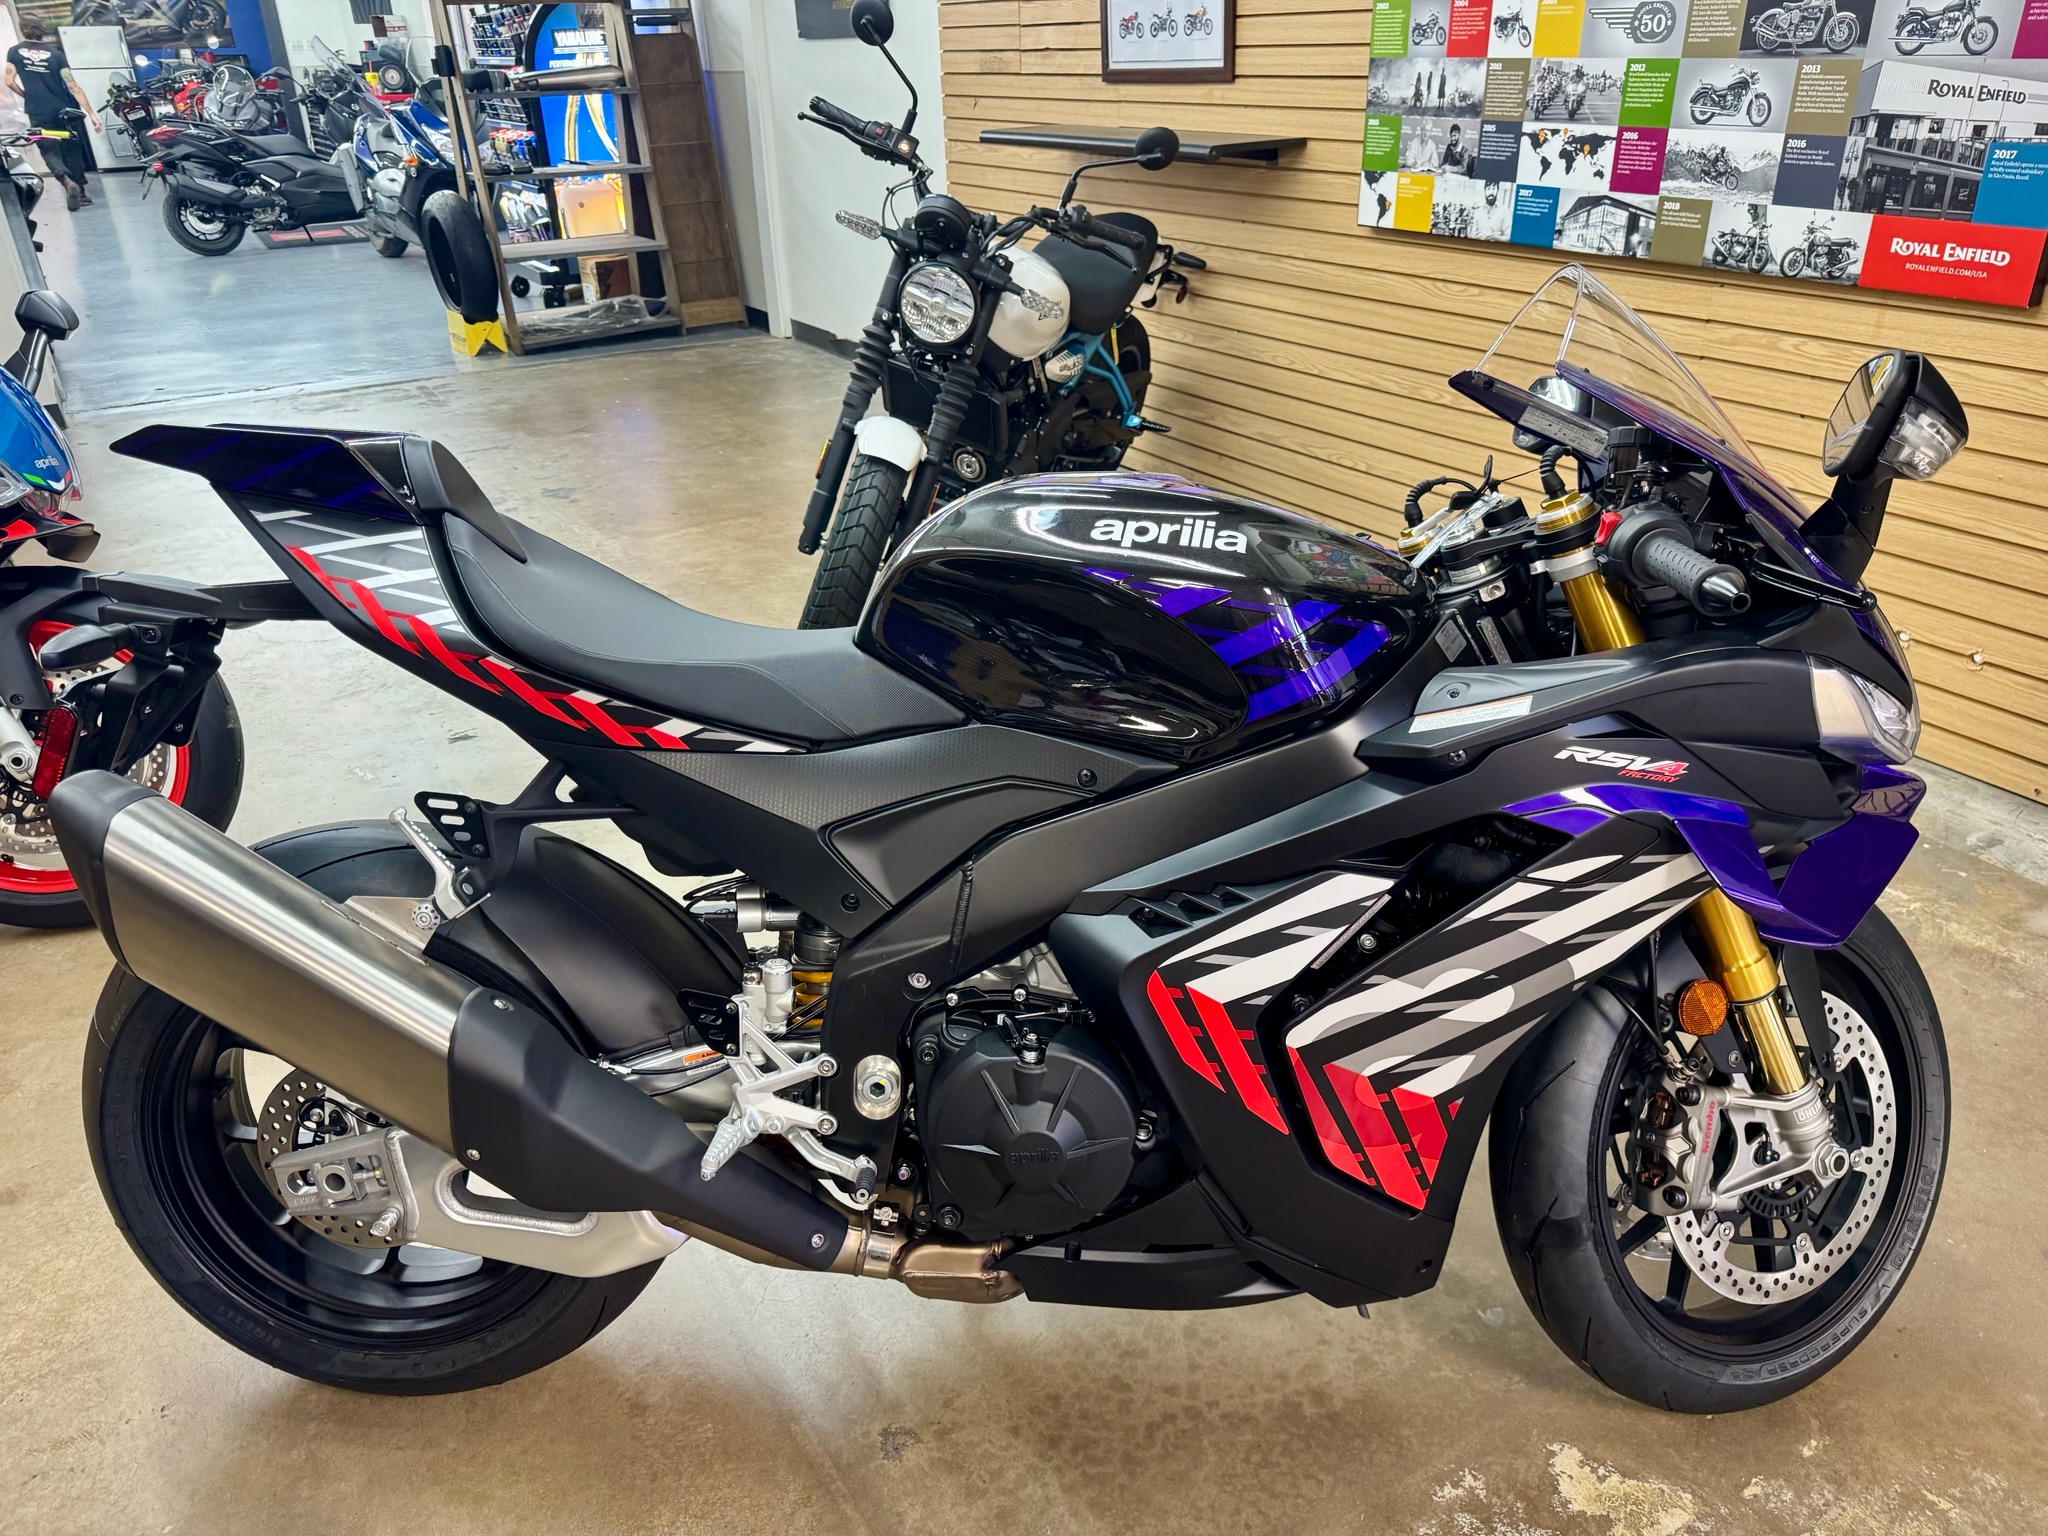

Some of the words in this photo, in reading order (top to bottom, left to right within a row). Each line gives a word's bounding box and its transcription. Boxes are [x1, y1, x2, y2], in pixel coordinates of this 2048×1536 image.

[1637, 4, 1652, 18] ROYAL
[1653, 3, 1672, 18] ENFIELD
[1640, 14, 1666, 32] 50
[554, 30, 606, 46] YAMALUBE
[1801, 64, 1821, 73] 2013
[1927, 79, 1974, 98] ROYAL
[1977, 85, 2026, 104] ENFIELD
[1622, 131, 1639, 140] 2016
[1787, 139, 1806, 148] 2016
[1993, 150, 2018, 159] 2017
[1663, 201, 1680, 210] 2018
[1890, 237, 1940, 258] ROYAL
[1943, 243, 2010, 266] ENFIELD
[1905, 263, 1987, 278] ROYALENFIELD.COM/USA
[34, 456, 60, 470] aprilia
[1090, 518, 1248, 554] aprilia
[1554, 746, 1690, 776] RSV4
[1618, 770, 1680, 783] FACTORY
[1797, 1098, 1821, 1120] ÖHLIN
[1701, 1100, 1716, 1154] brembo
[1010, 1148, 1058, 1164] aprilia
[1891, 1167, 1936, 1270] DIABLO
[1767, 1306, 1868, 1376] SUPERCORSA
